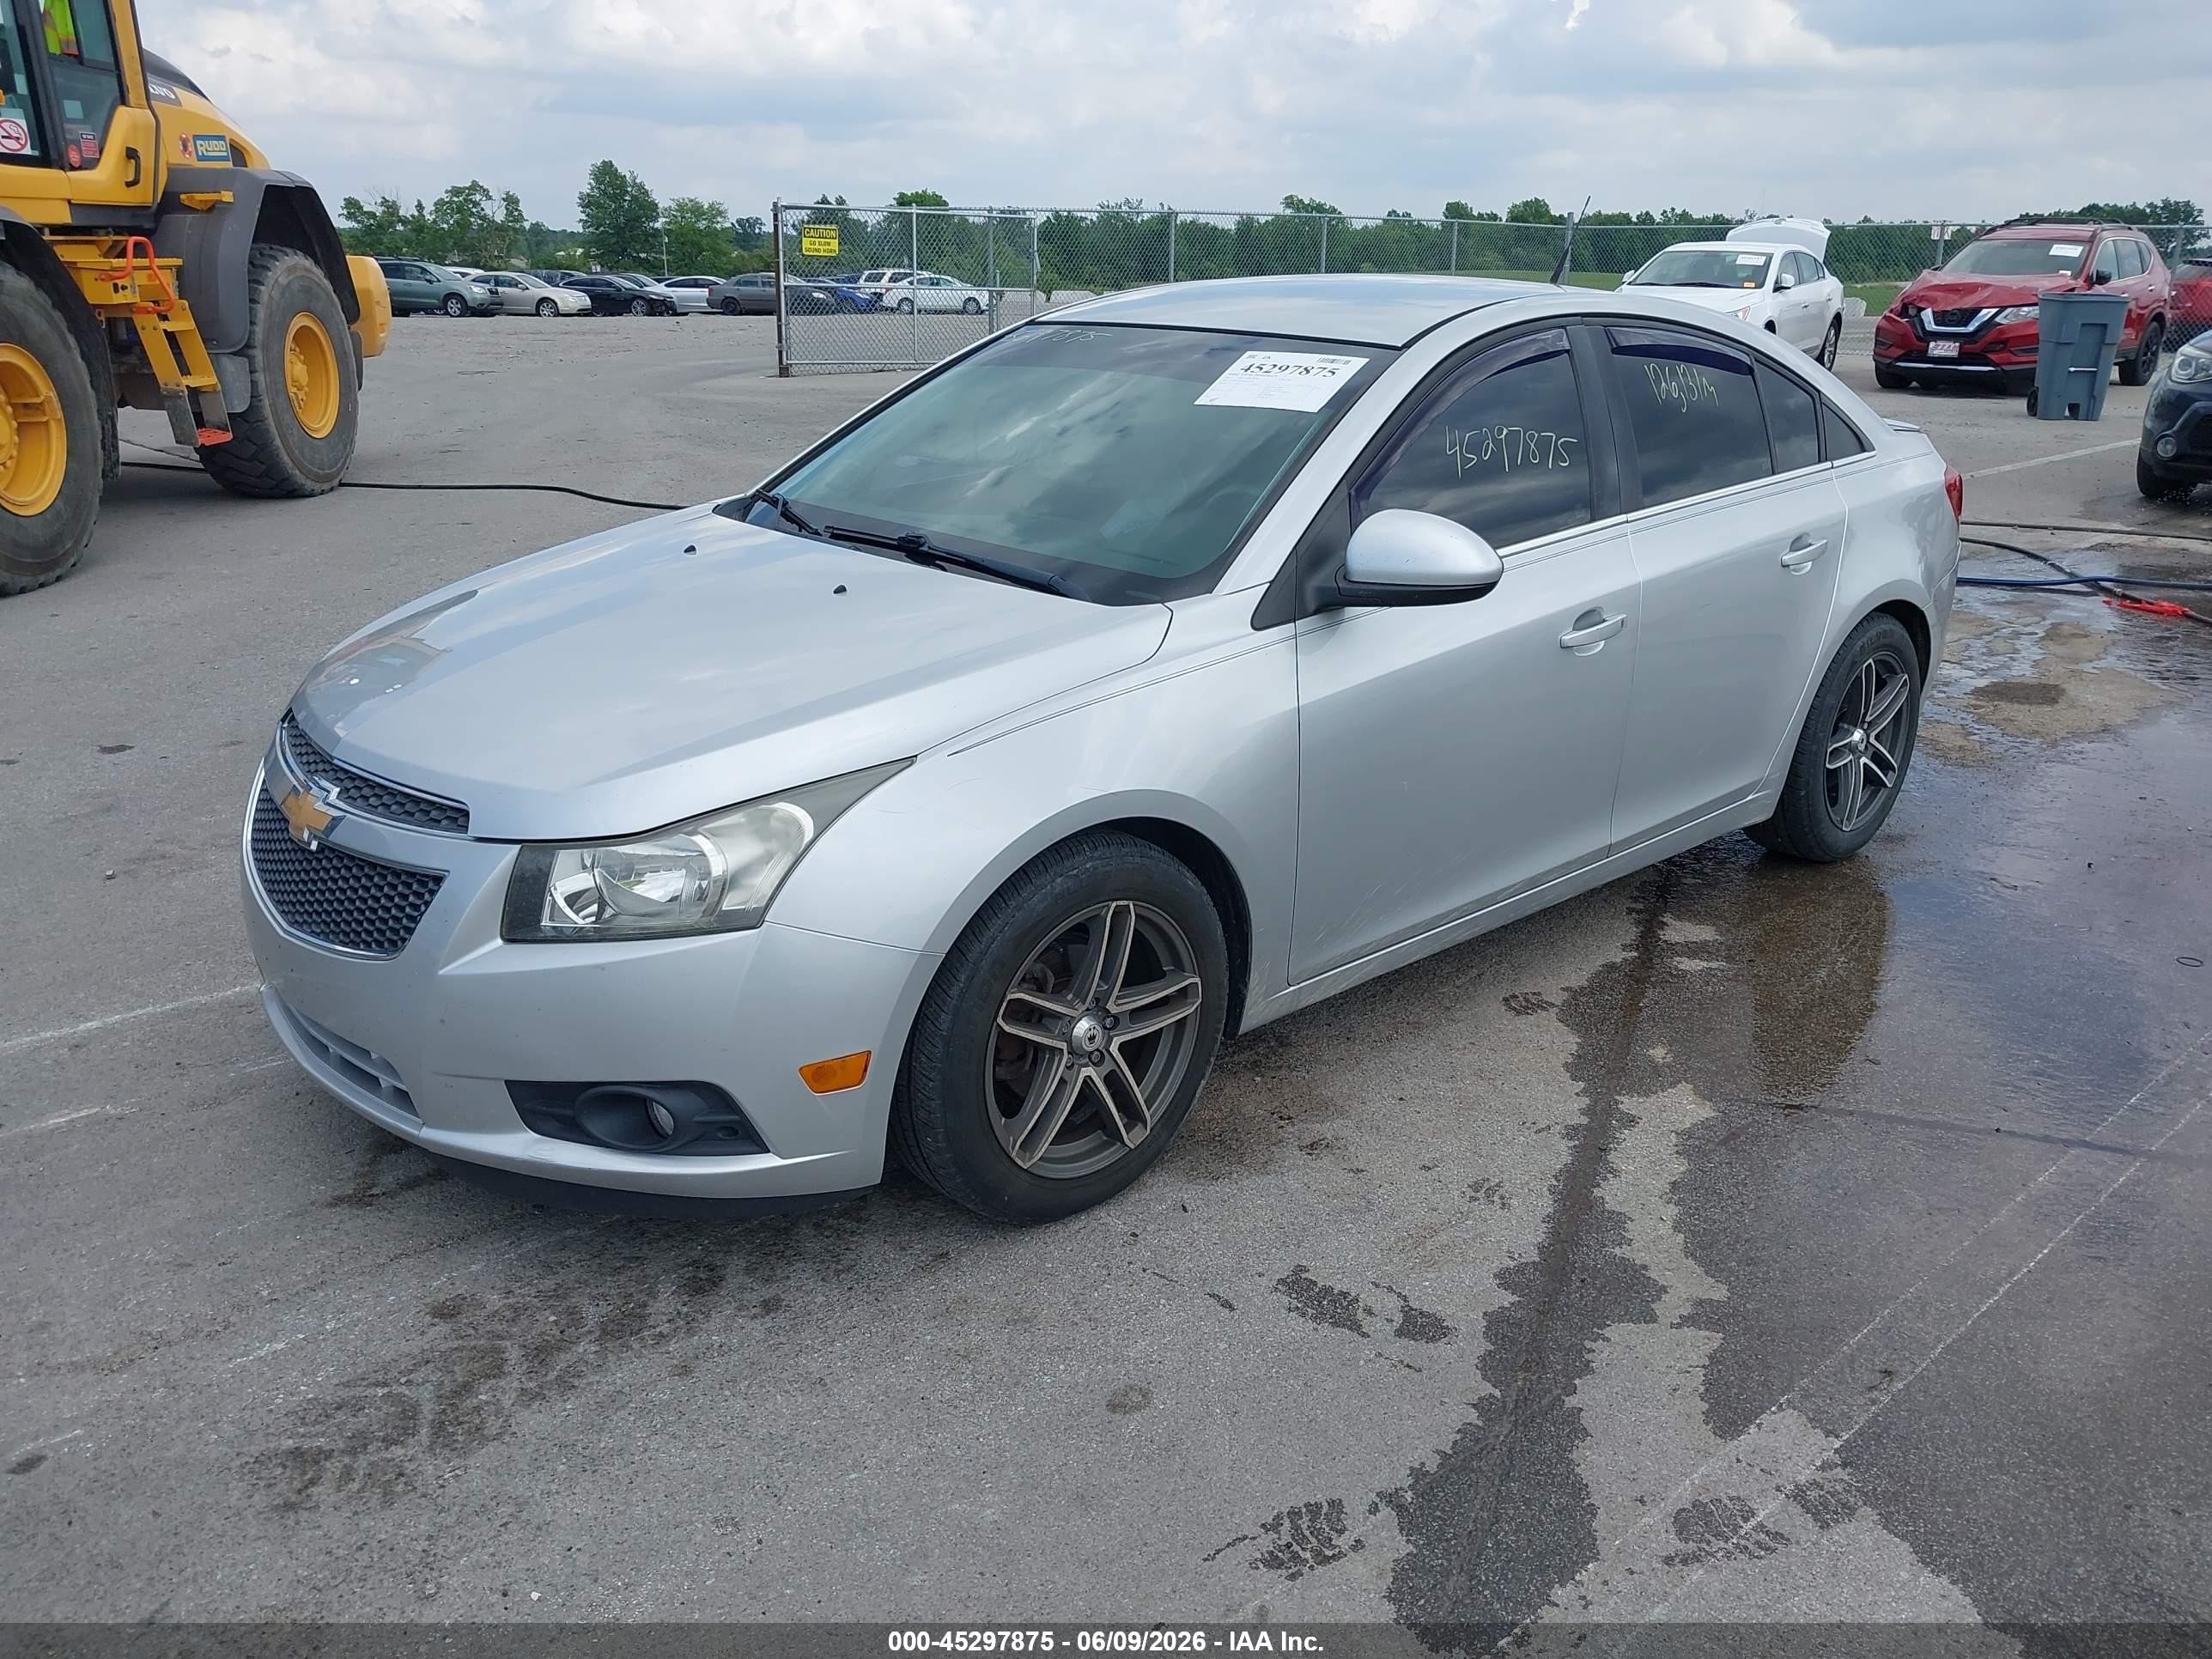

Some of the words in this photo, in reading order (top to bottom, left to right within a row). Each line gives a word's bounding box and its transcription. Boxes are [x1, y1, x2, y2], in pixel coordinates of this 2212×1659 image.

[196, 140, 227, 156] RUDD
[805, 228, 836, 238] CAUTION
[1240, 362, 1340, 378] 45297875
[1445, 425, 1579, 480] 45297875
